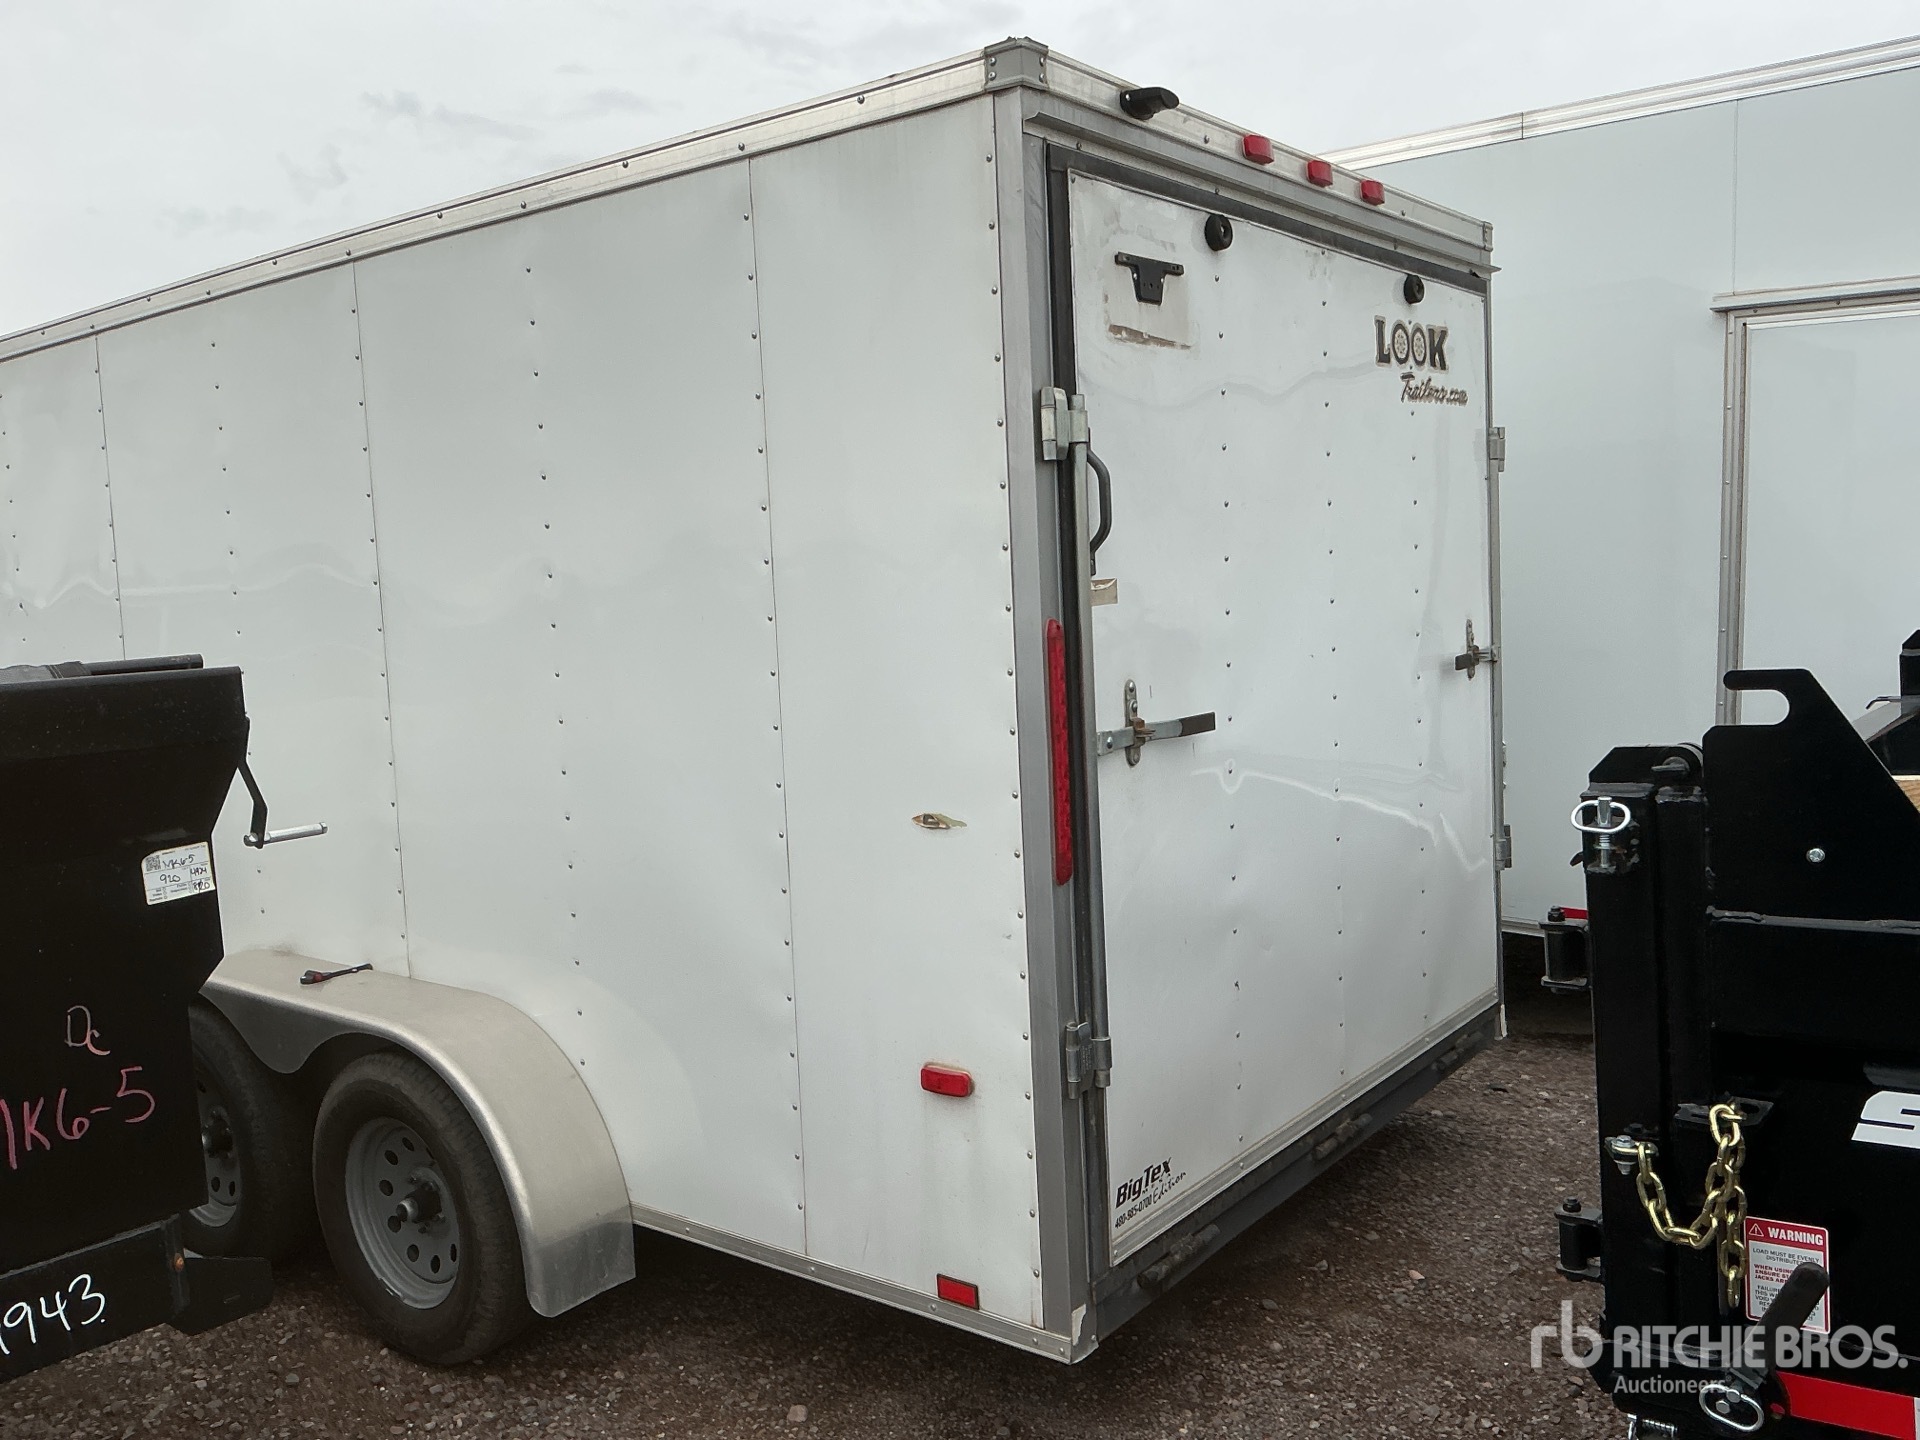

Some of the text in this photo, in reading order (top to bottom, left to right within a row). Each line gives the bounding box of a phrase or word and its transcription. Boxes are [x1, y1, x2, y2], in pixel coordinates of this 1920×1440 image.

[1374, 315, 1449, 373] LOOK
[0, 1066, 156, 1170] K6-5
[1767, 1226, 1824, 1246] WARNING
[1769, 1250, 1787, 1258] MUST
[1797, 1255, 1820, 1264] EVENLY
[1754, 1270, 1781, 1278] ENSURE
